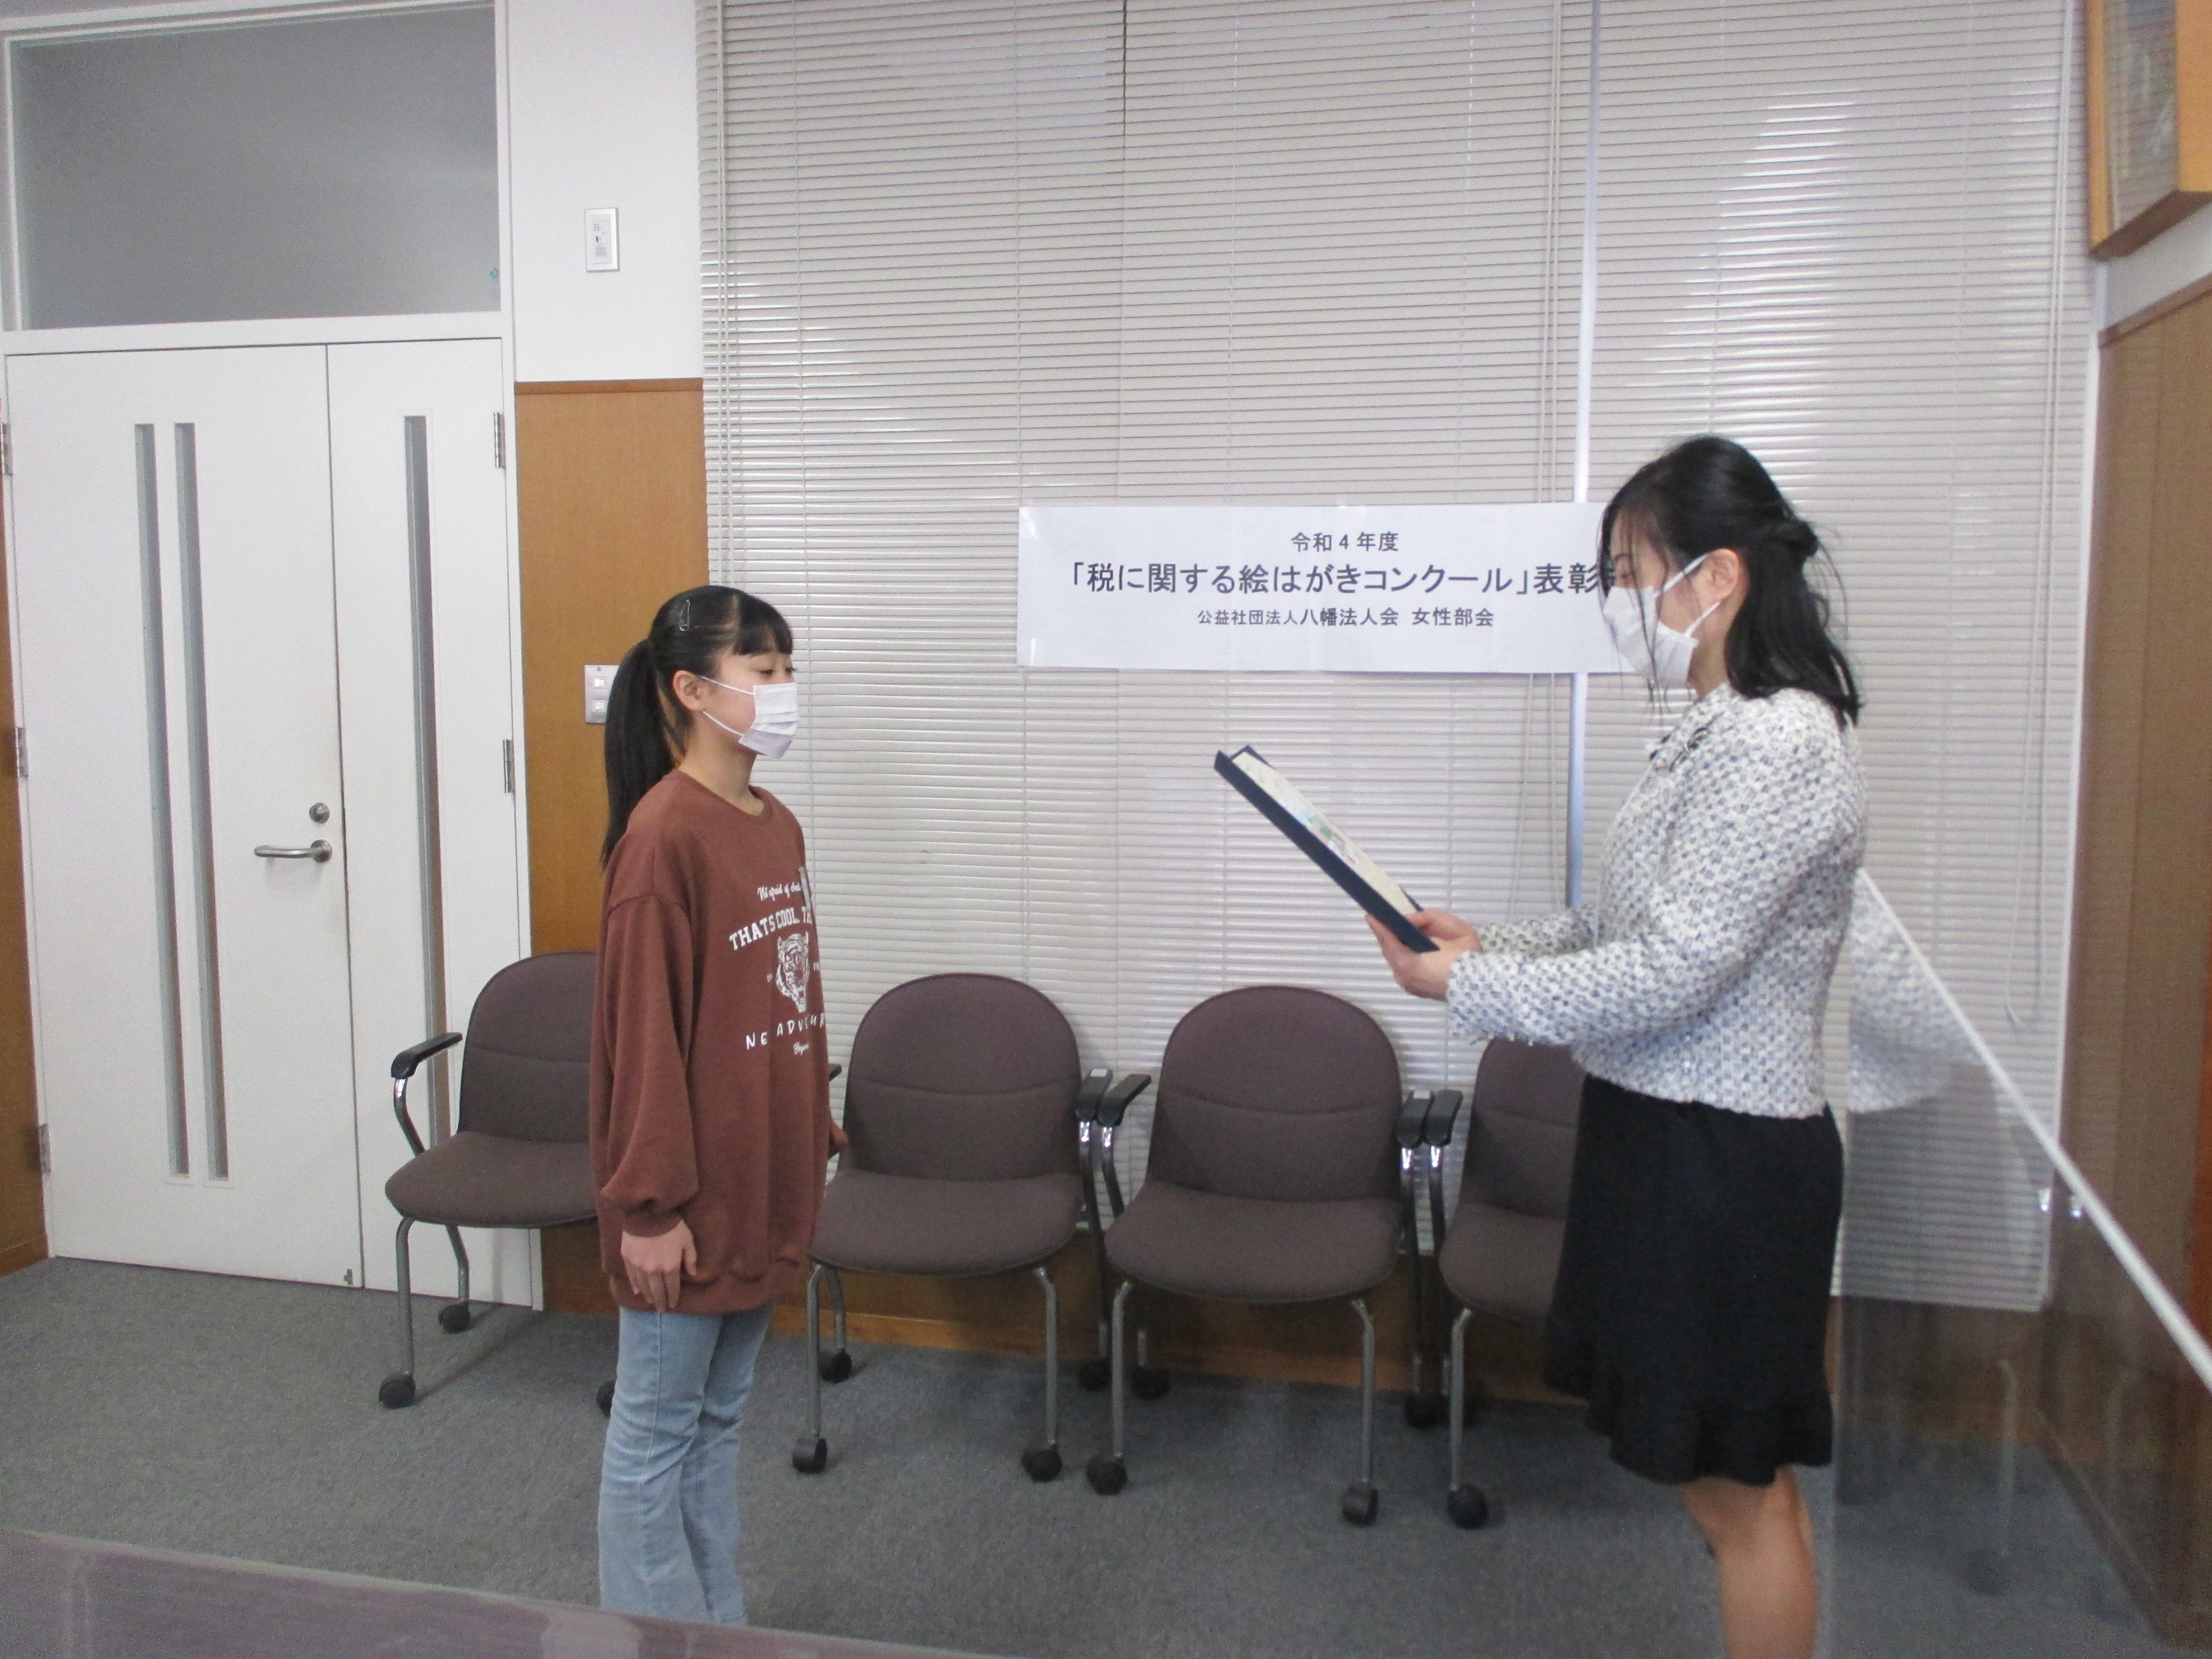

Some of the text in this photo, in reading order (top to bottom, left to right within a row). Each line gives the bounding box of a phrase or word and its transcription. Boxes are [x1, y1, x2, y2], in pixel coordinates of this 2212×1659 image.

[1291, 531, 1398, 552] 令和4年度
[1074, 562, 1616, 595] 「税に関する絵はがきコンクール」表彰
[1412, 607, 1493, 626] 女性部会
